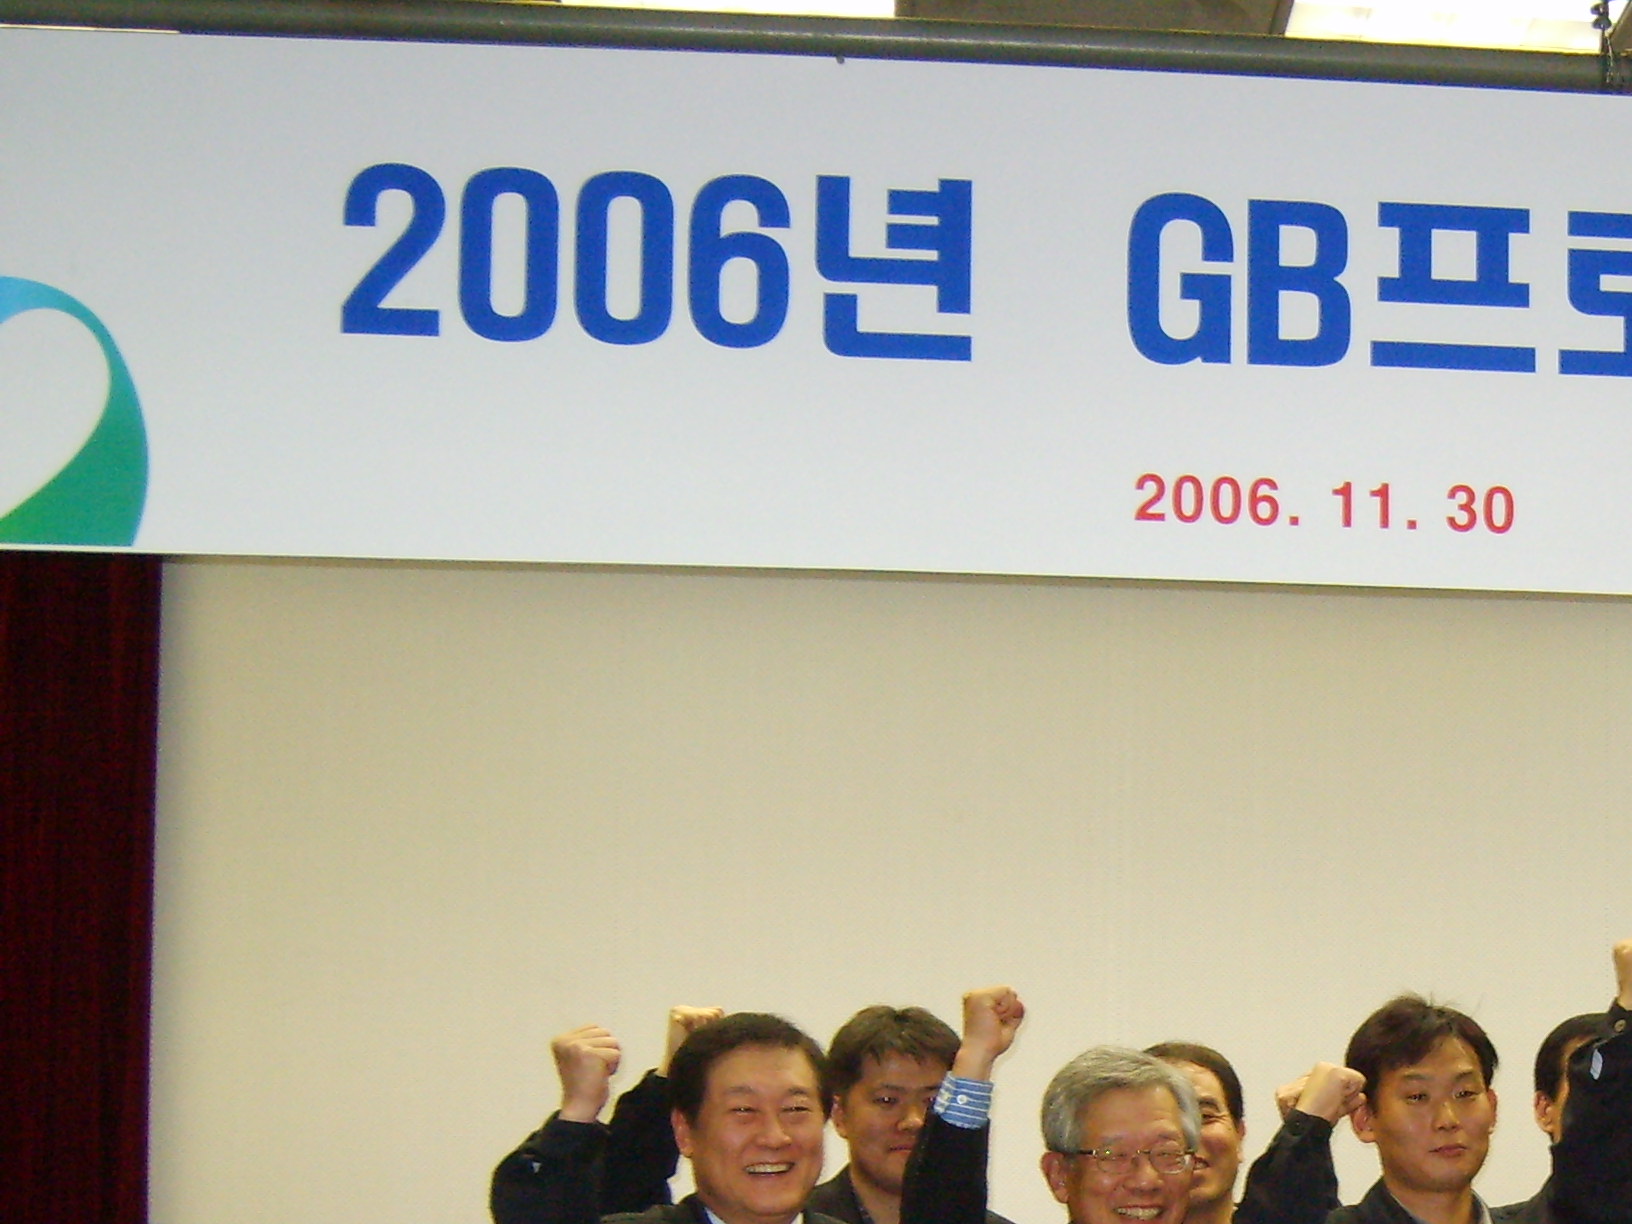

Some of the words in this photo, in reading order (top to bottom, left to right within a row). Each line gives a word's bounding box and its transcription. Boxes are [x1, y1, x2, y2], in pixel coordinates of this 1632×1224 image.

[342, 163, 974, 363] 2006년
[1134, 472, 1300, 525] 2006.
[1446, 483, 1515, 533] 30
